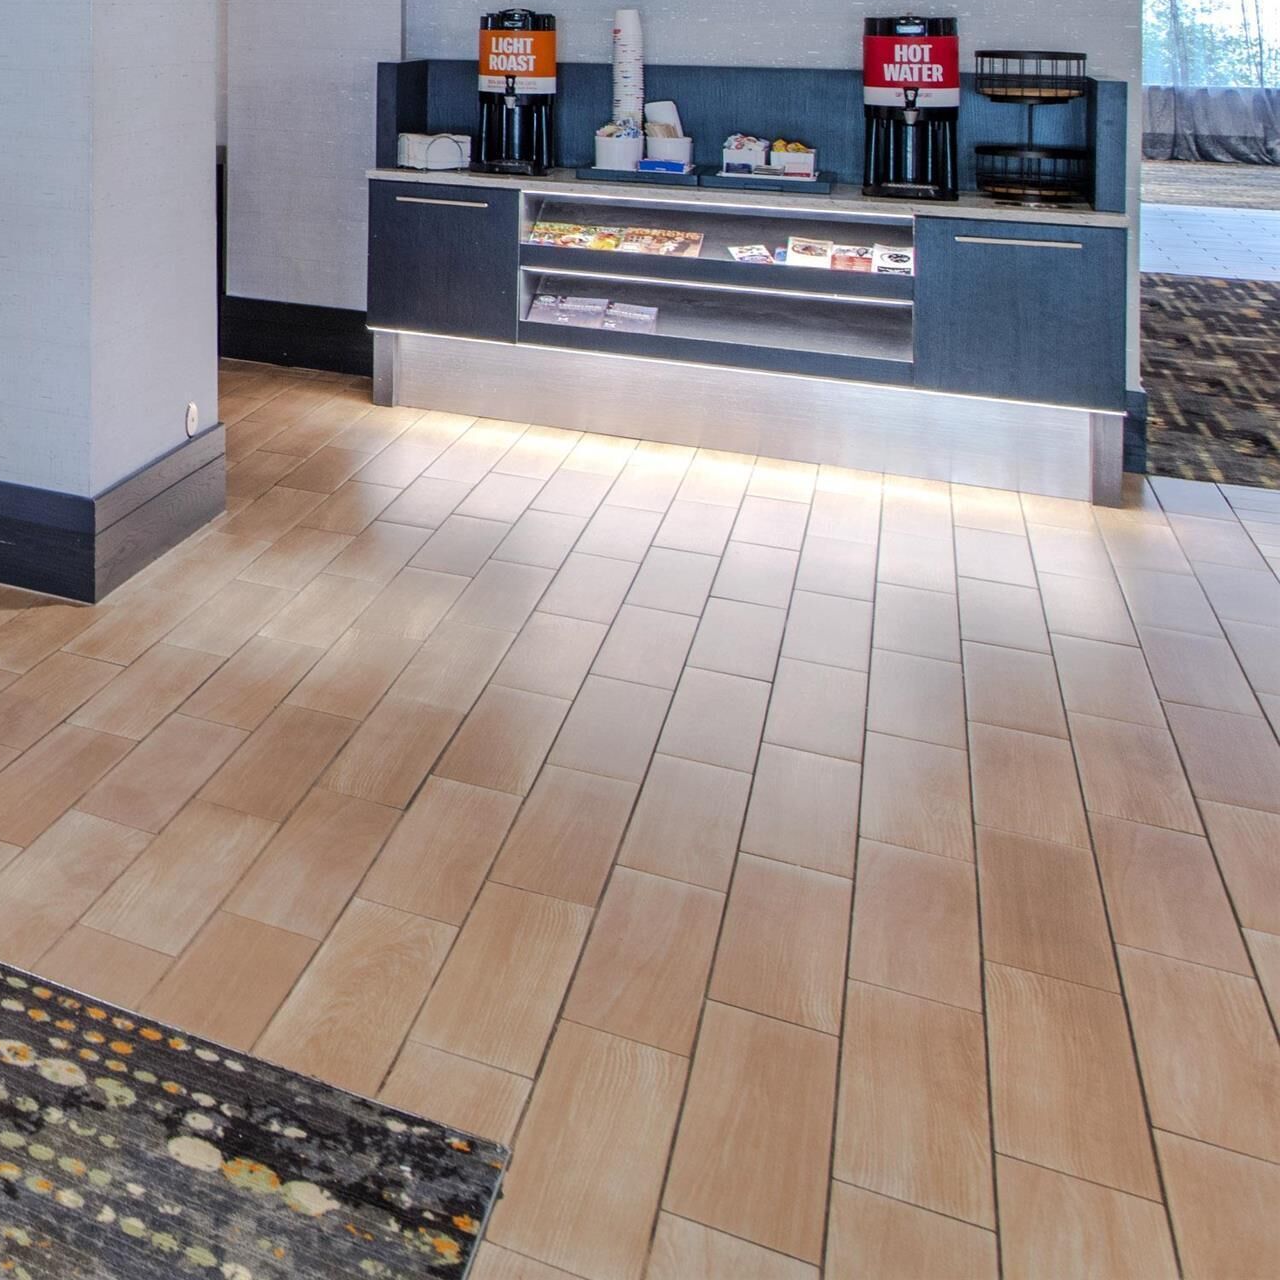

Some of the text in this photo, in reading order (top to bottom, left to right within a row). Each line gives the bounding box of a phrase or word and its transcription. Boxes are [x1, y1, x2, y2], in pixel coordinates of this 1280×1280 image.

[491, 36, 535, 54] LIGHT
[894, 44, 933, 63] HOT
[488, 54, 537, 72] ROAST
[883, 63, 944, 82] WATER
